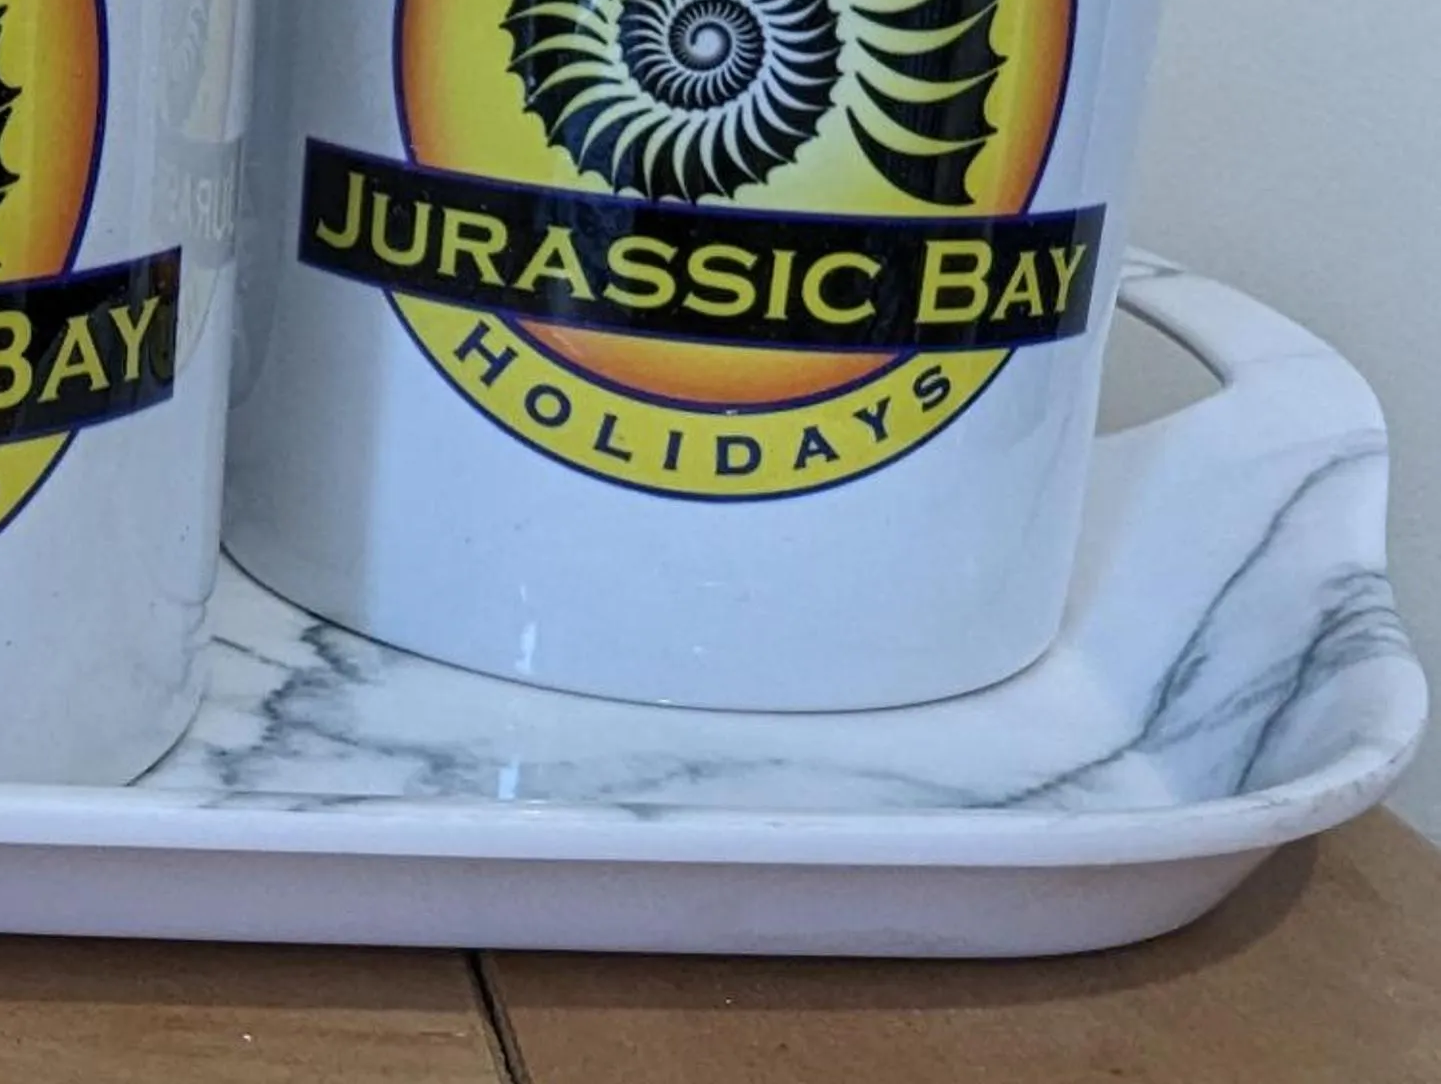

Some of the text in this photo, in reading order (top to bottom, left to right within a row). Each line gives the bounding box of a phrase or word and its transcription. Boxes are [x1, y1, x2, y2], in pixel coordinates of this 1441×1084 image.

[315, 171, 882, 324] JURASSIC
[916, 239, 1087, 325] BAY
[453, 319, 952, 477] HOLIDAYS
